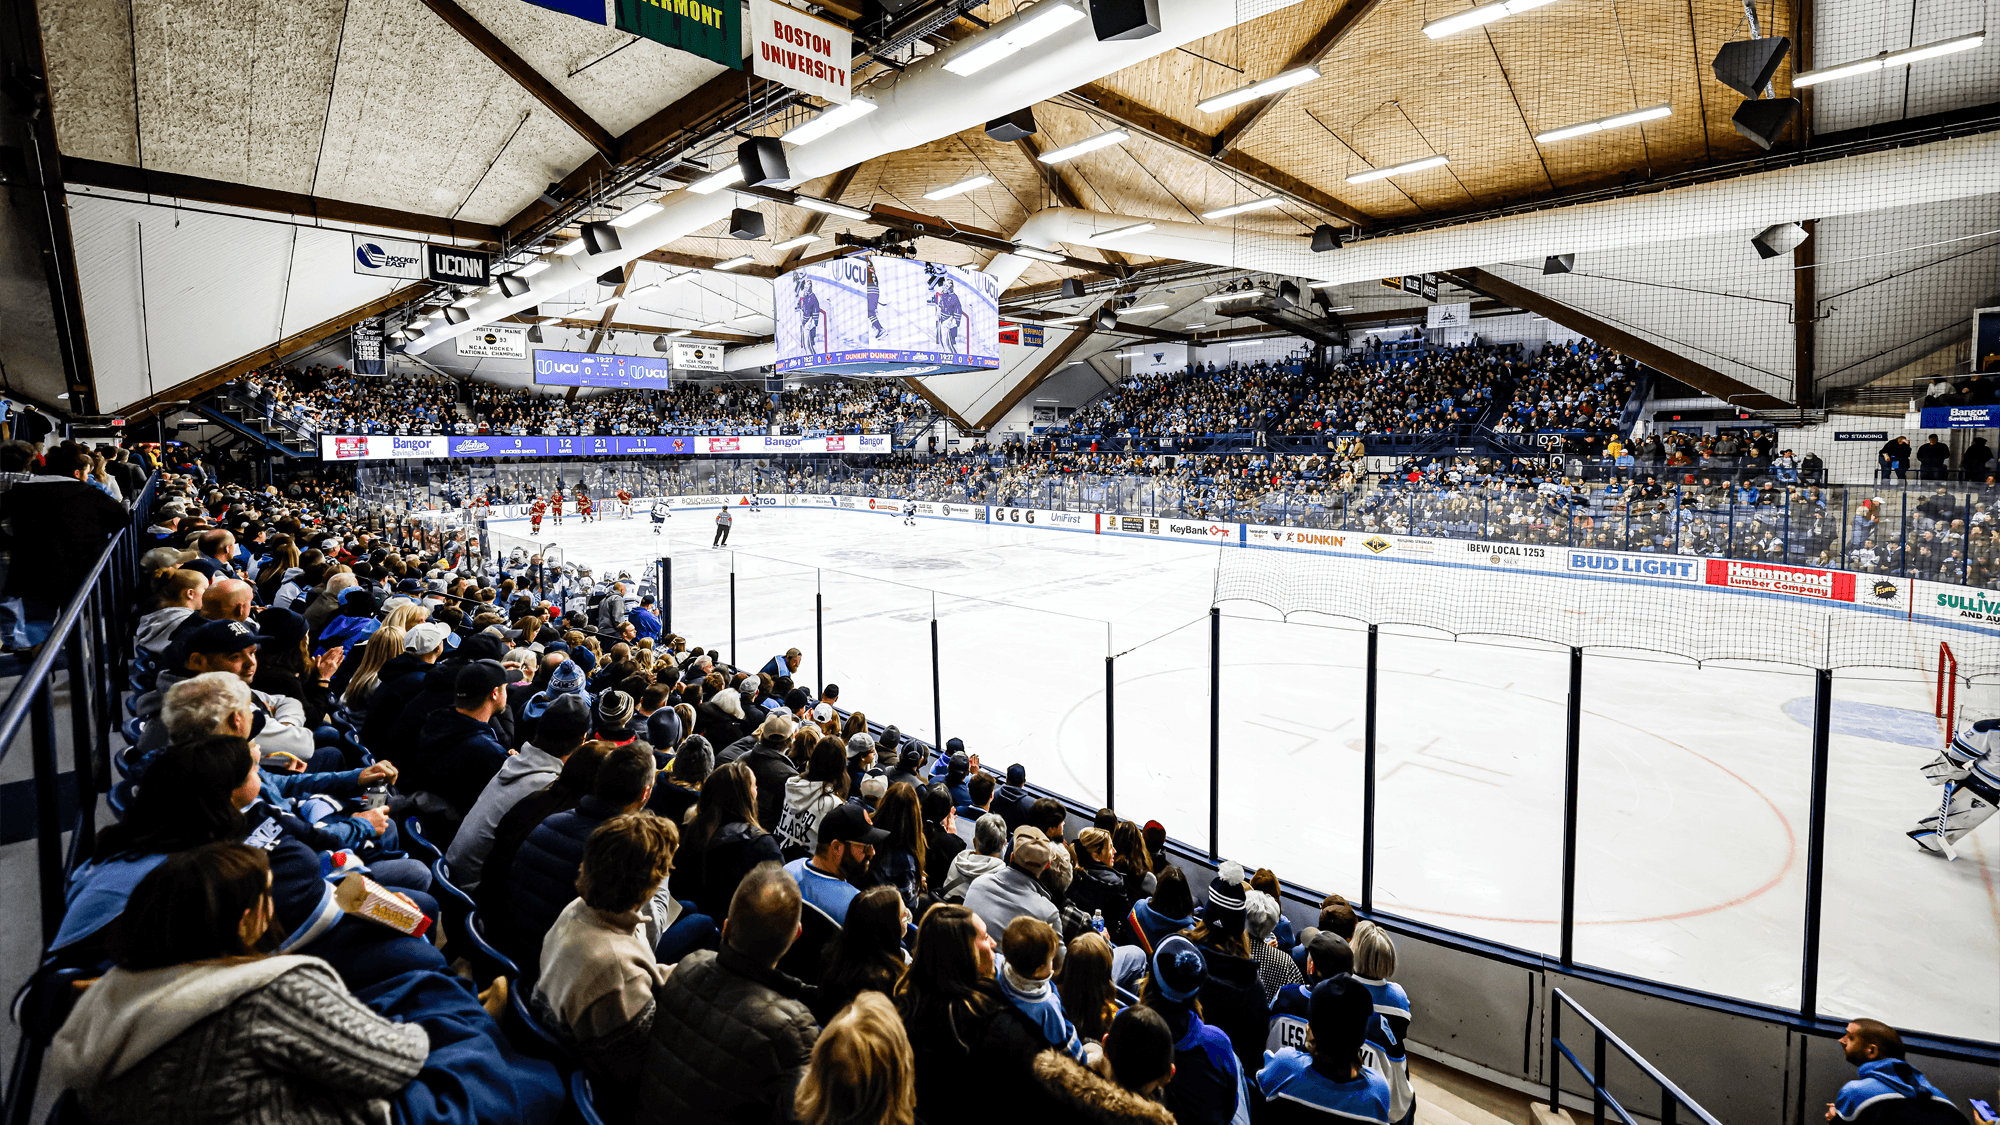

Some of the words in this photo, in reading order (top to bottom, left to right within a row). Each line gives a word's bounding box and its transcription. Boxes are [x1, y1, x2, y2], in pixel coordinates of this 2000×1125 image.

[643, 0, 722, 29] RMONT
[774, 20, 831, 57] BOSTON
[761, 41, 845, 86] UNIVERSITY
[387, 256, 419, 264] HOCKEY
[436, 253, 483, 278] UCONN
[845, 262, 866, 286] UCU
[845, 352, 869, 360] DUNKIN'
[870, 352, 898, 360] DUNKIN'
[554, 363, 579, 373] UCU
[584, 367, 591, 375] 0
[619, 369, 625, 377] 0
[646, 369, 667, 378] UCU
[1951, 408, 1988, 417] Bangor
[393, 437, 431, 451] Bangor
[514, 439, 522, 448] 9
[559, 439, 572, 448] 12
[595, 439, 606, 447] 21
[636, 439, 647, 447] 11
[765, 437, 802, 447] Bangor
[859, 436, 884, 447] Bangor
[392, 449, 414, 457] Savings
[996, 508, 1004, 521] G
[1010, 509, 1019, 522] G
[1025, 510, 1034, 524] G
[1051, 512, 1081, 523] UniFirst
[1170, 524, 1208, 536] KeyBank
[1297, 532, 1346, 547] DUNKIN'
[1467, 544, 1490, 553] IBEW
[1492, 545, 1520, 555] LOCAL
[1524, 548, 1545, 557] 1253
[1571, 554, 1618, 571] BUD
[1623, 558, 1693, 577] LIGHT
[1728, 562, 1833, 587] Hammond
[1730, 576, 1770, 589] Lumber
[1774, 581, 1828, 597] Company
[1960, 611, 1983, 619] AND
[777, 814, 810, 842] LACK
